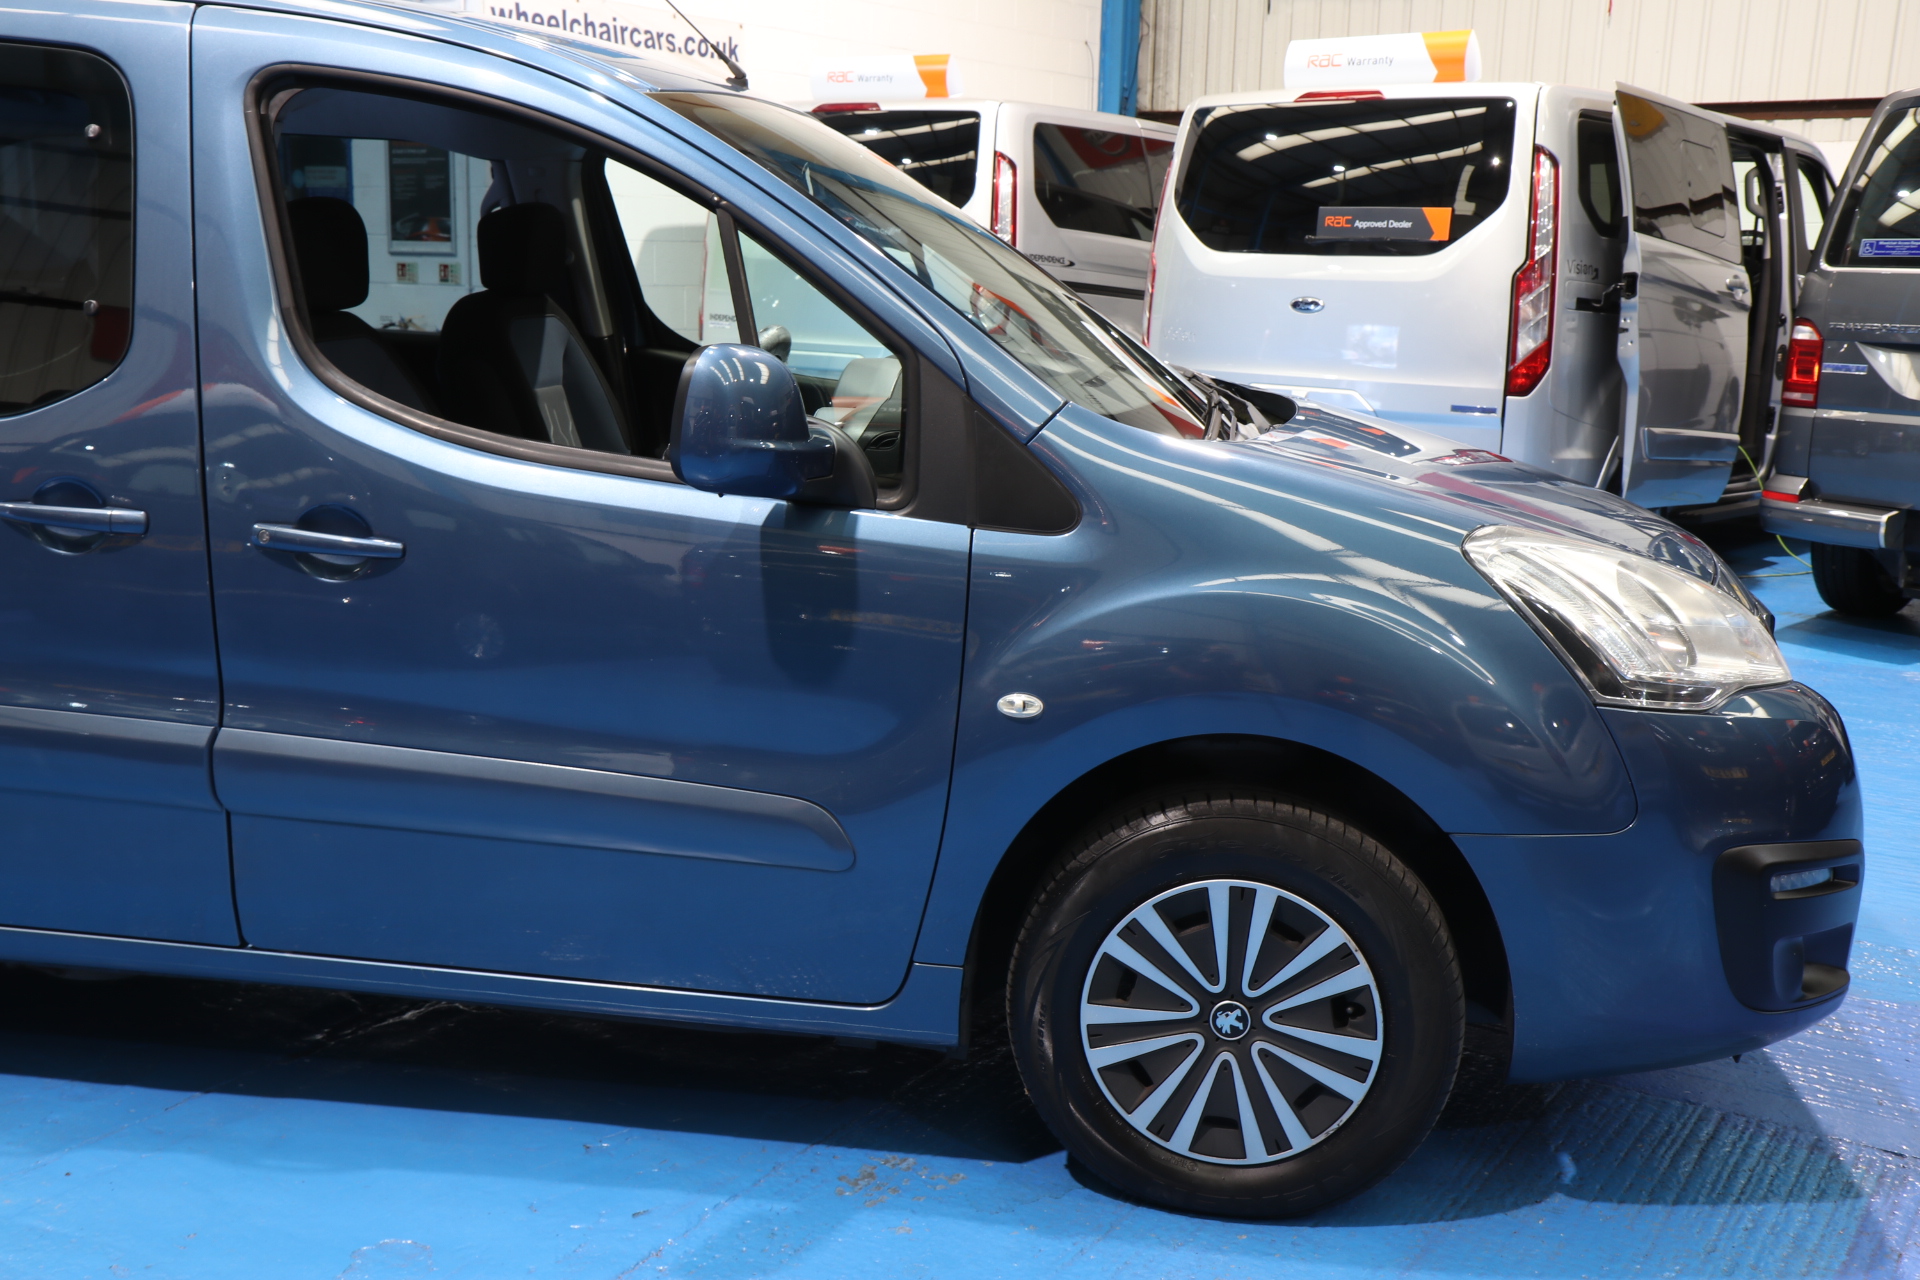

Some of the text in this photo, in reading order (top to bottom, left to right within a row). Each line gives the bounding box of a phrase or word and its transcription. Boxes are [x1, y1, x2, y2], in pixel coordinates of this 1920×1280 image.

[490, 2, 739, 62] wheelchaircars.co.uk
[1347, 56, 1394, 67] Warranty
[857, 74, 893, 83] Warranty
[1353, 219, 1388, 229] Approved
[1388, 219, 1413, 228] Dealer
